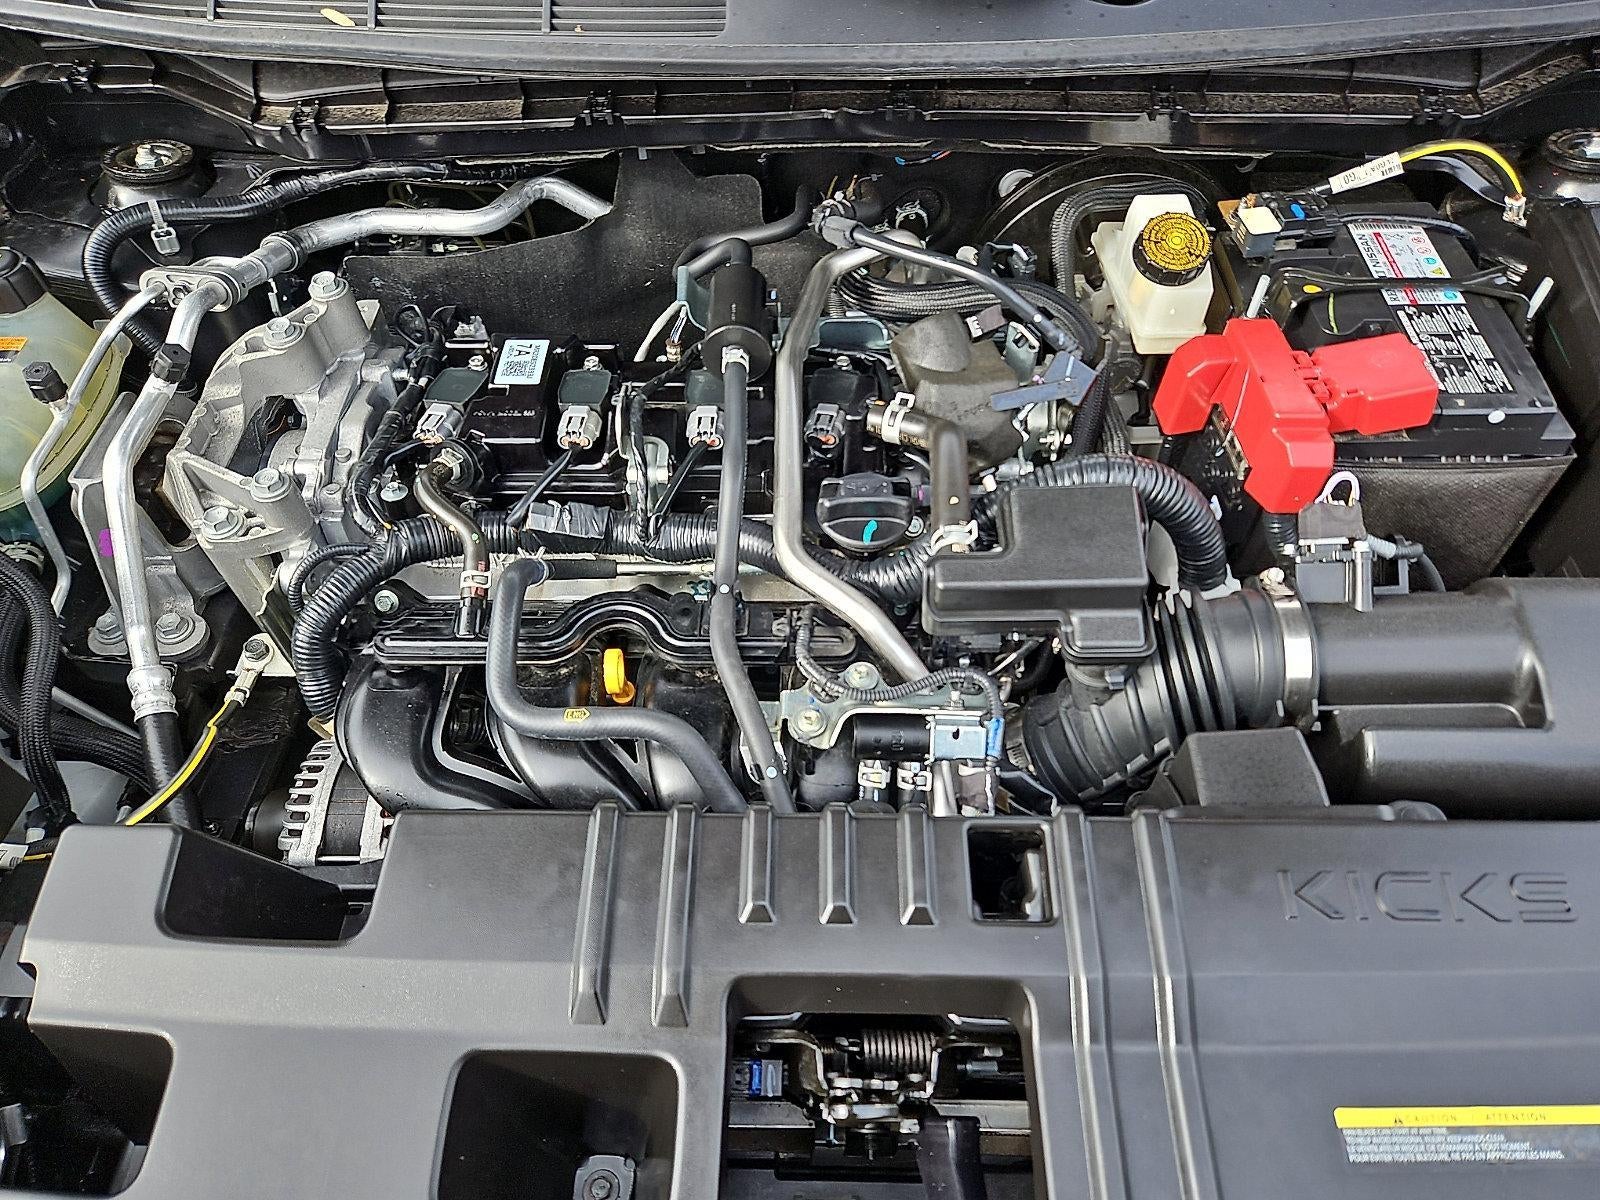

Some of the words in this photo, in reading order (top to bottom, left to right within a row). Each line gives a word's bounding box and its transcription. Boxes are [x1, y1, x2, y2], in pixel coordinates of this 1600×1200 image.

[1355, 233, 1383, 268] NISSAN
[514, 343, 533, 358] 7A
[1276, 868, 1578, 923] KICKS
[1486, 1112, 1546, 1121] ATTENTION
